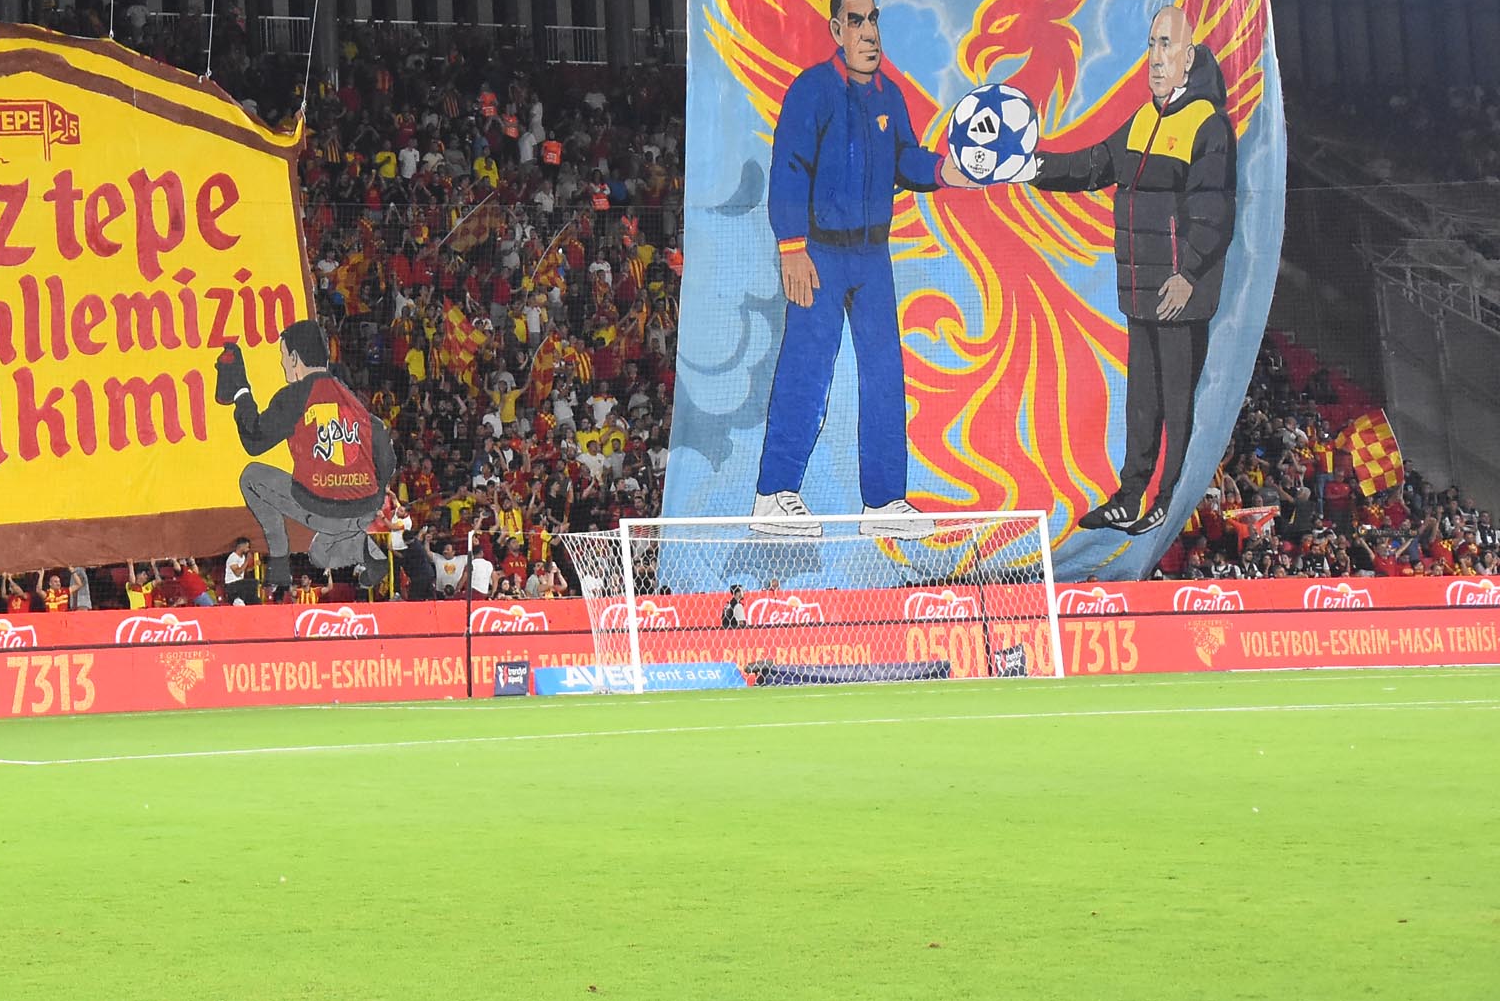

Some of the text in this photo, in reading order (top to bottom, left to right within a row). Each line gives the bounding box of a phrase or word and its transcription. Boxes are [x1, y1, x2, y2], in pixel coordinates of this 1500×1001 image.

[312, 472, 370, 487] SUSUZDEDE
[1065, 619, 1139, 673] 7313
[1240, 624, 1445, 658] VOLEYBOL-ESKRİM-MASA
[6, 652, 96, 714] 7313
[650, 668, 685, 681] rent
[686, 670, 695, 680] a
[697, 668, 722, 680] car
